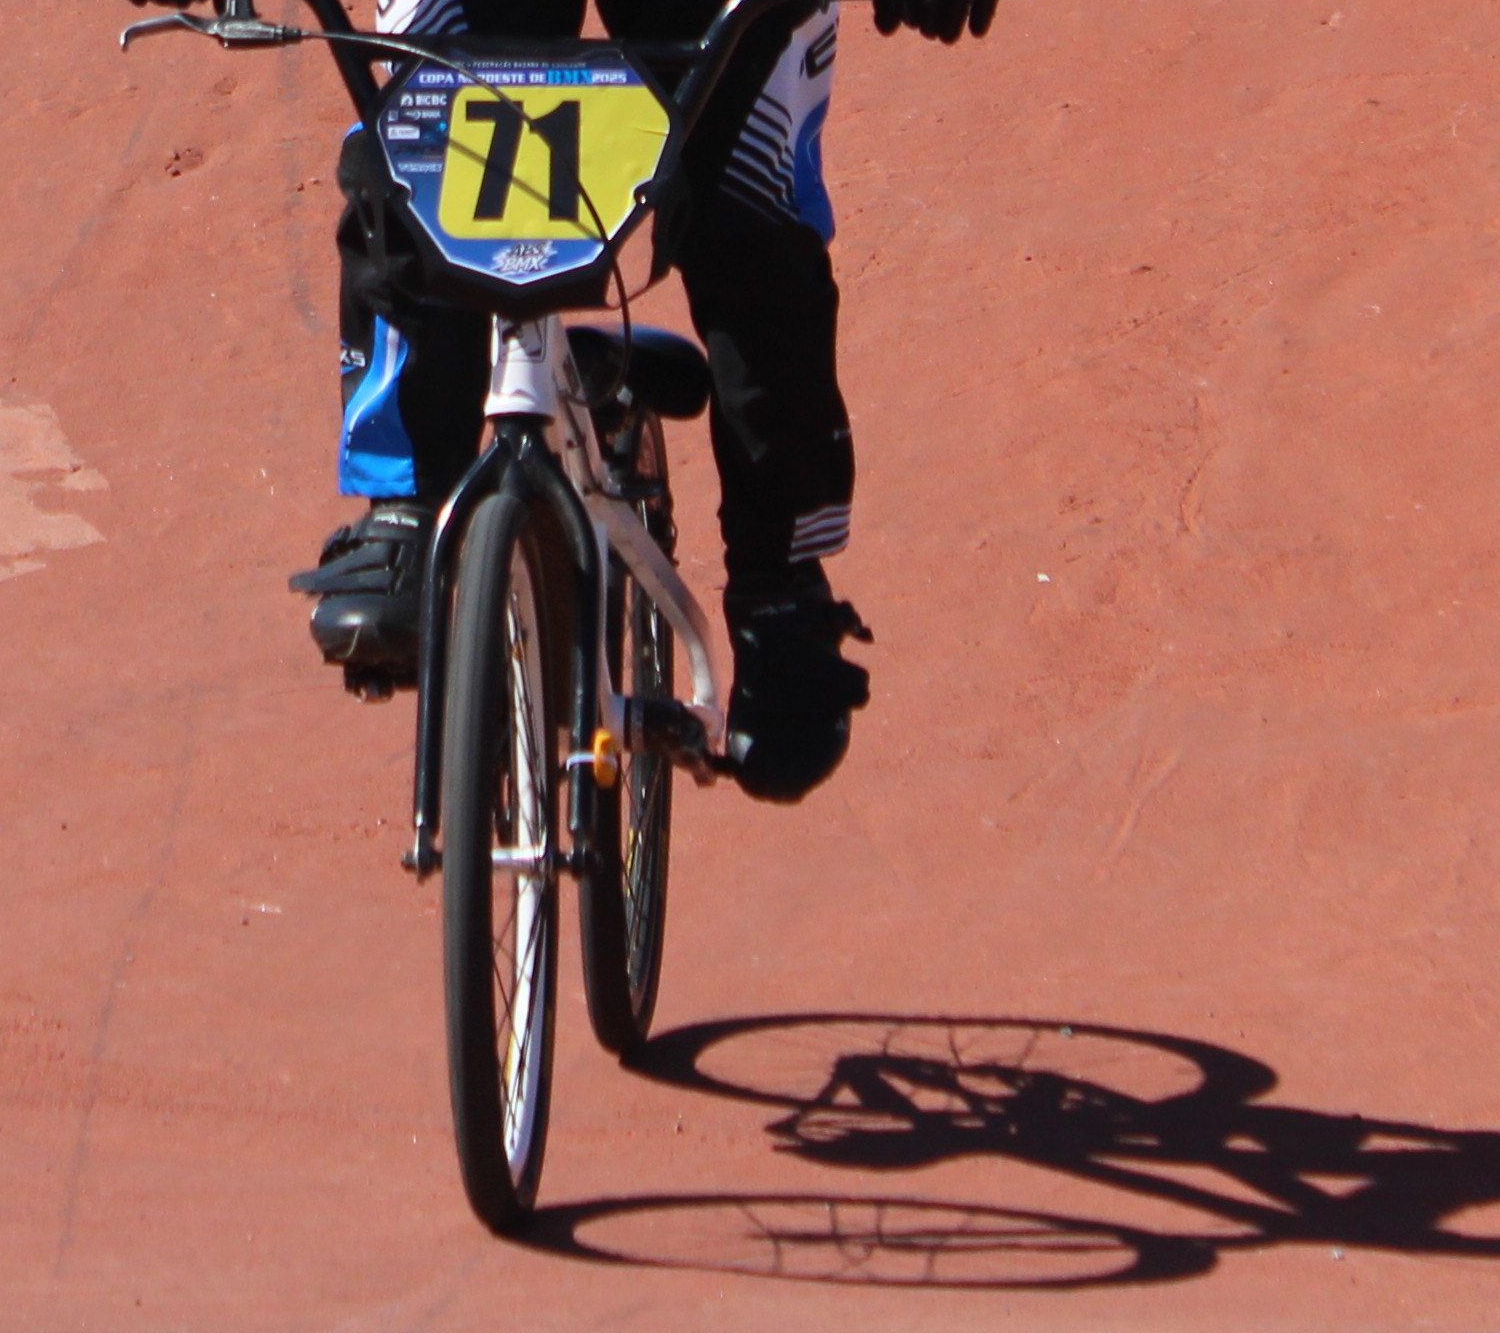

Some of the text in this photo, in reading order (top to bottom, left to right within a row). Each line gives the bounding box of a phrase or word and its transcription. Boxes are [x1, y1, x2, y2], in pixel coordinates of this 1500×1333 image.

[419, 72, 454, 84] COPA
[458, 72, 526, 84] NRDESTE
[465, 100, 581, 222] 71
